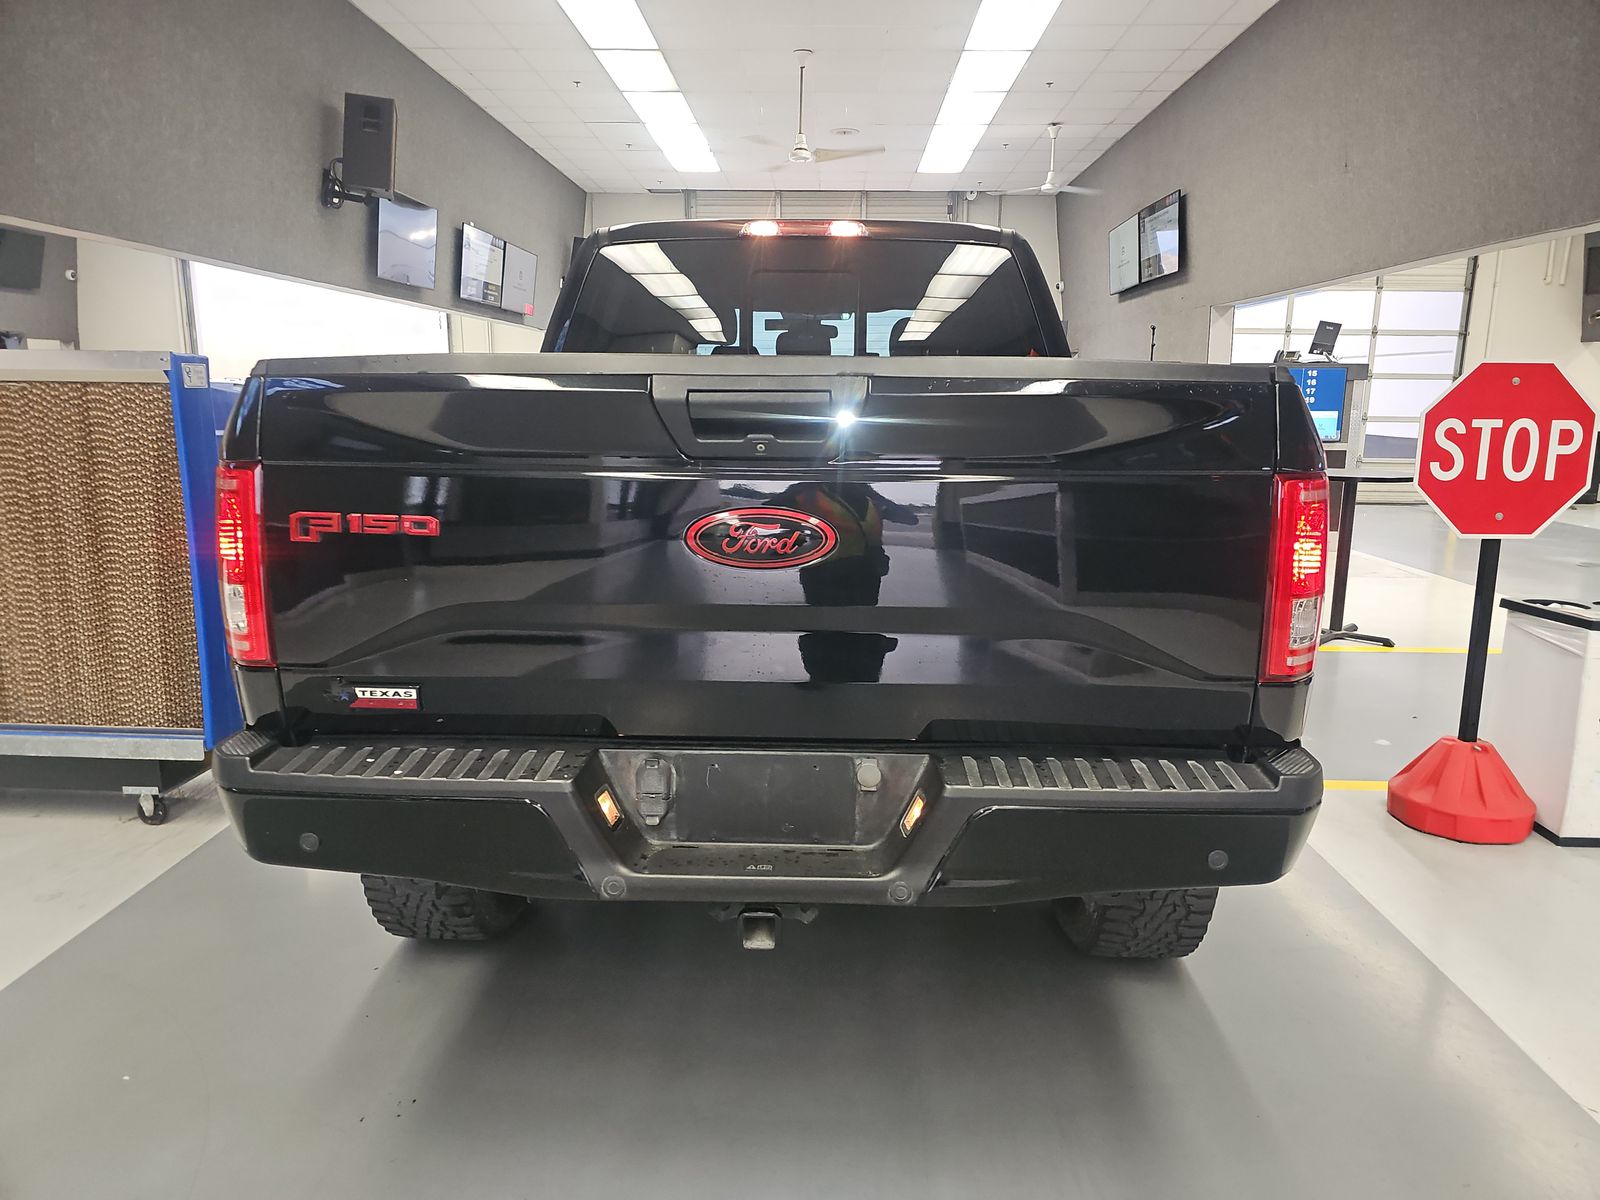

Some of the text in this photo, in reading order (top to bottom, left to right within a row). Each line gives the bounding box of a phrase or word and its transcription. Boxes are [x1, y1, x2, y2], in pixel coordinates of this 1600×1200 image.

[1307, 369, 1318, 377] 15
[1429, 417, 1584, 482] STOP
[721, 521, 801, 554] Ford
[358, 690, 413, 698] TEXAS
